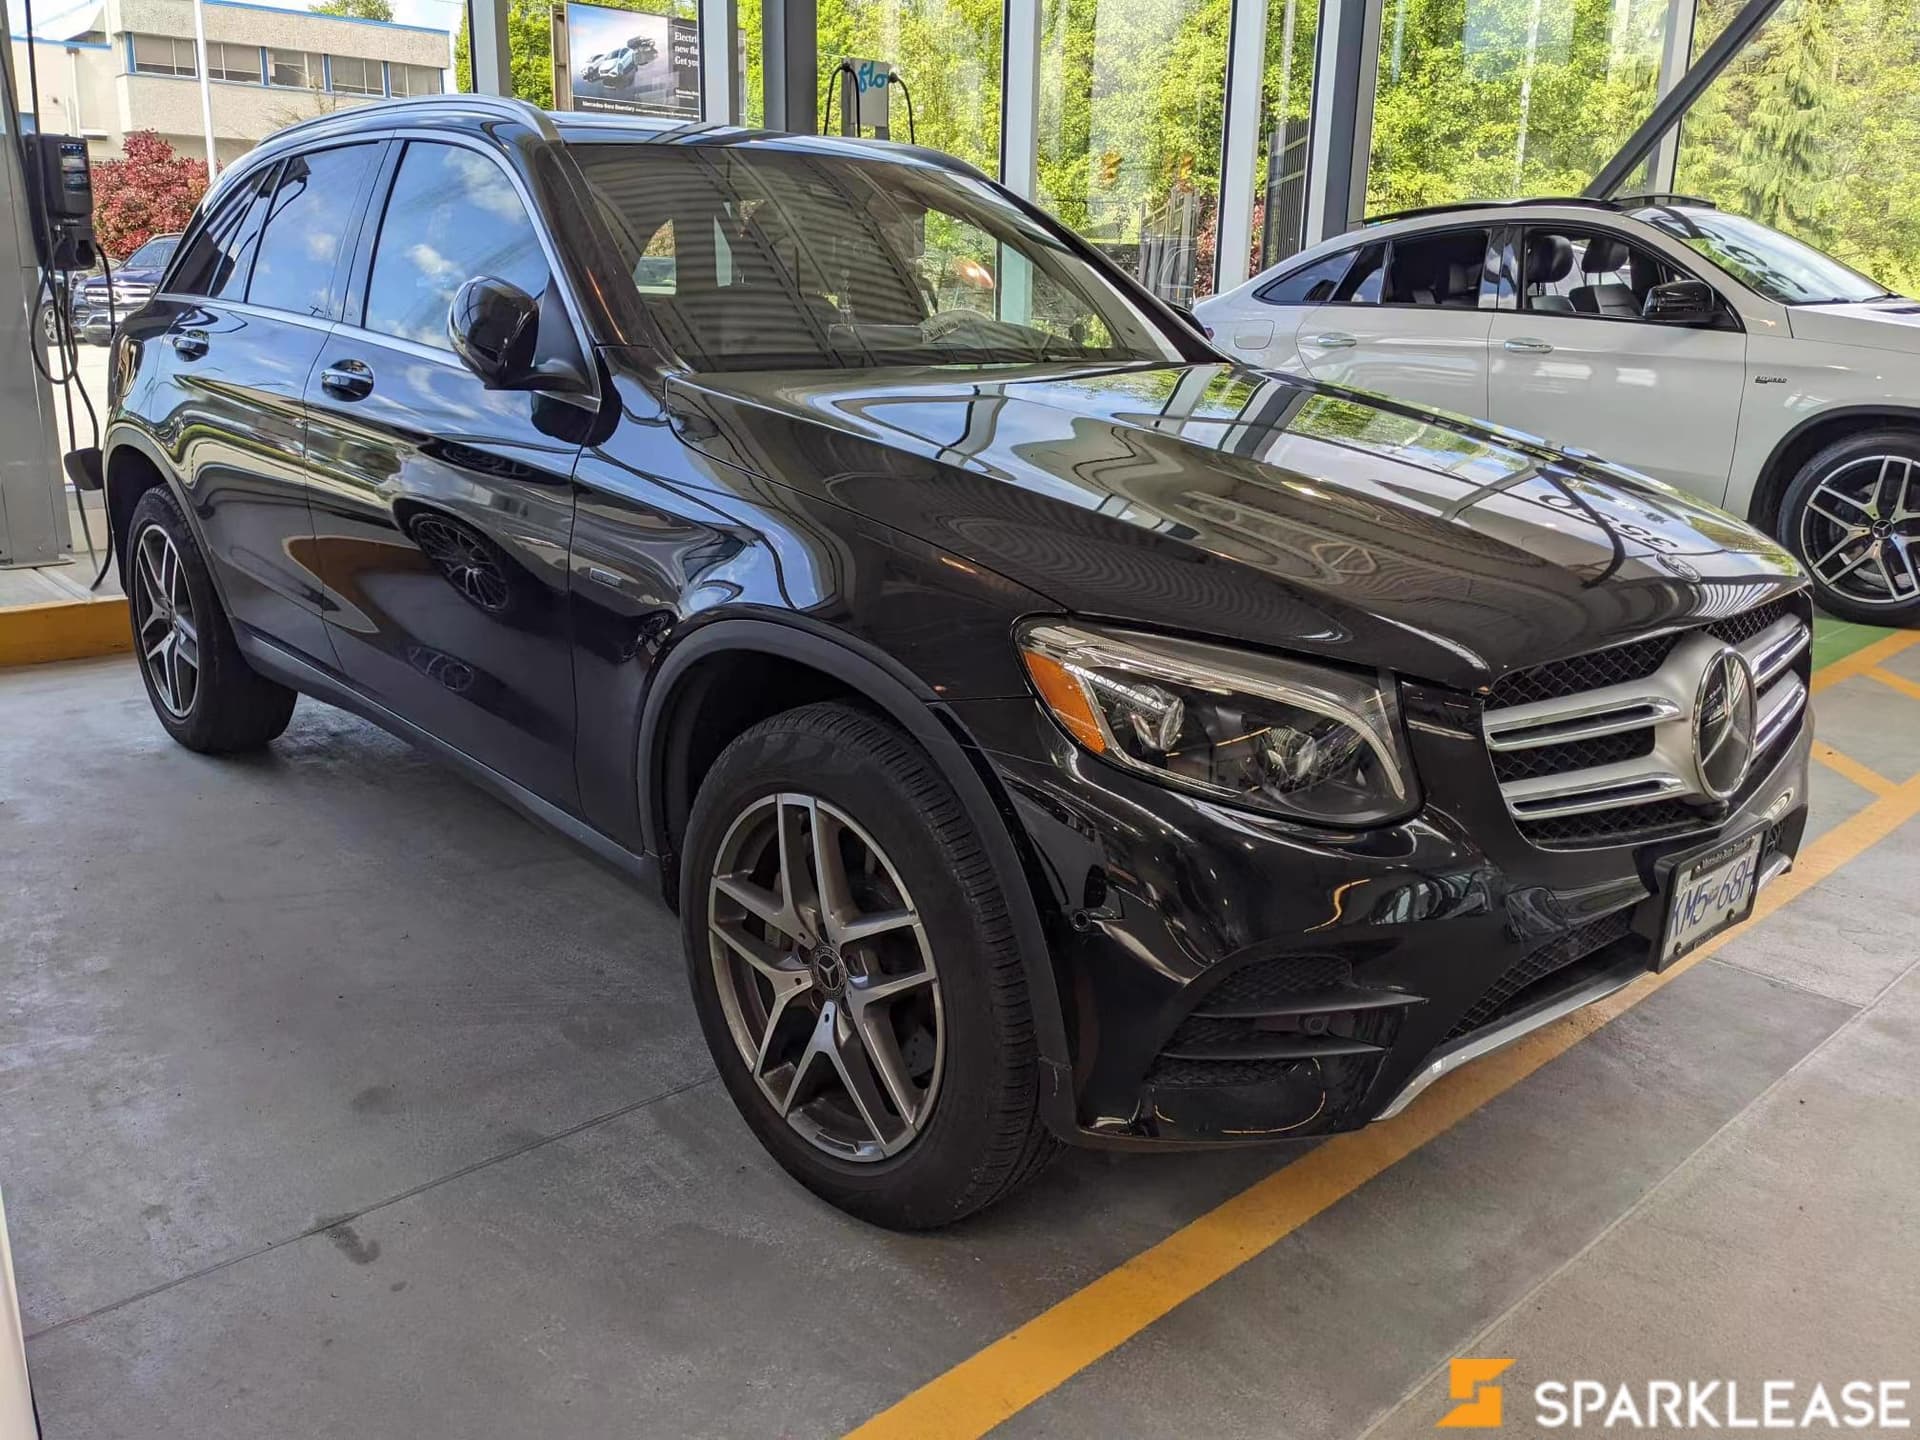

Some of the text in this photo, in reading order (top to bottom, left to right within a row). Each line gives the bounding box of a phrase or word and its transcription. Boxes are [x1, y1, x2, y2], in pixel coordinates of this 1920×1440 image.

[674, 45, 689, 54] new
[674, 56, 688, 65] Get
[858, 60, 889, 93] flo
